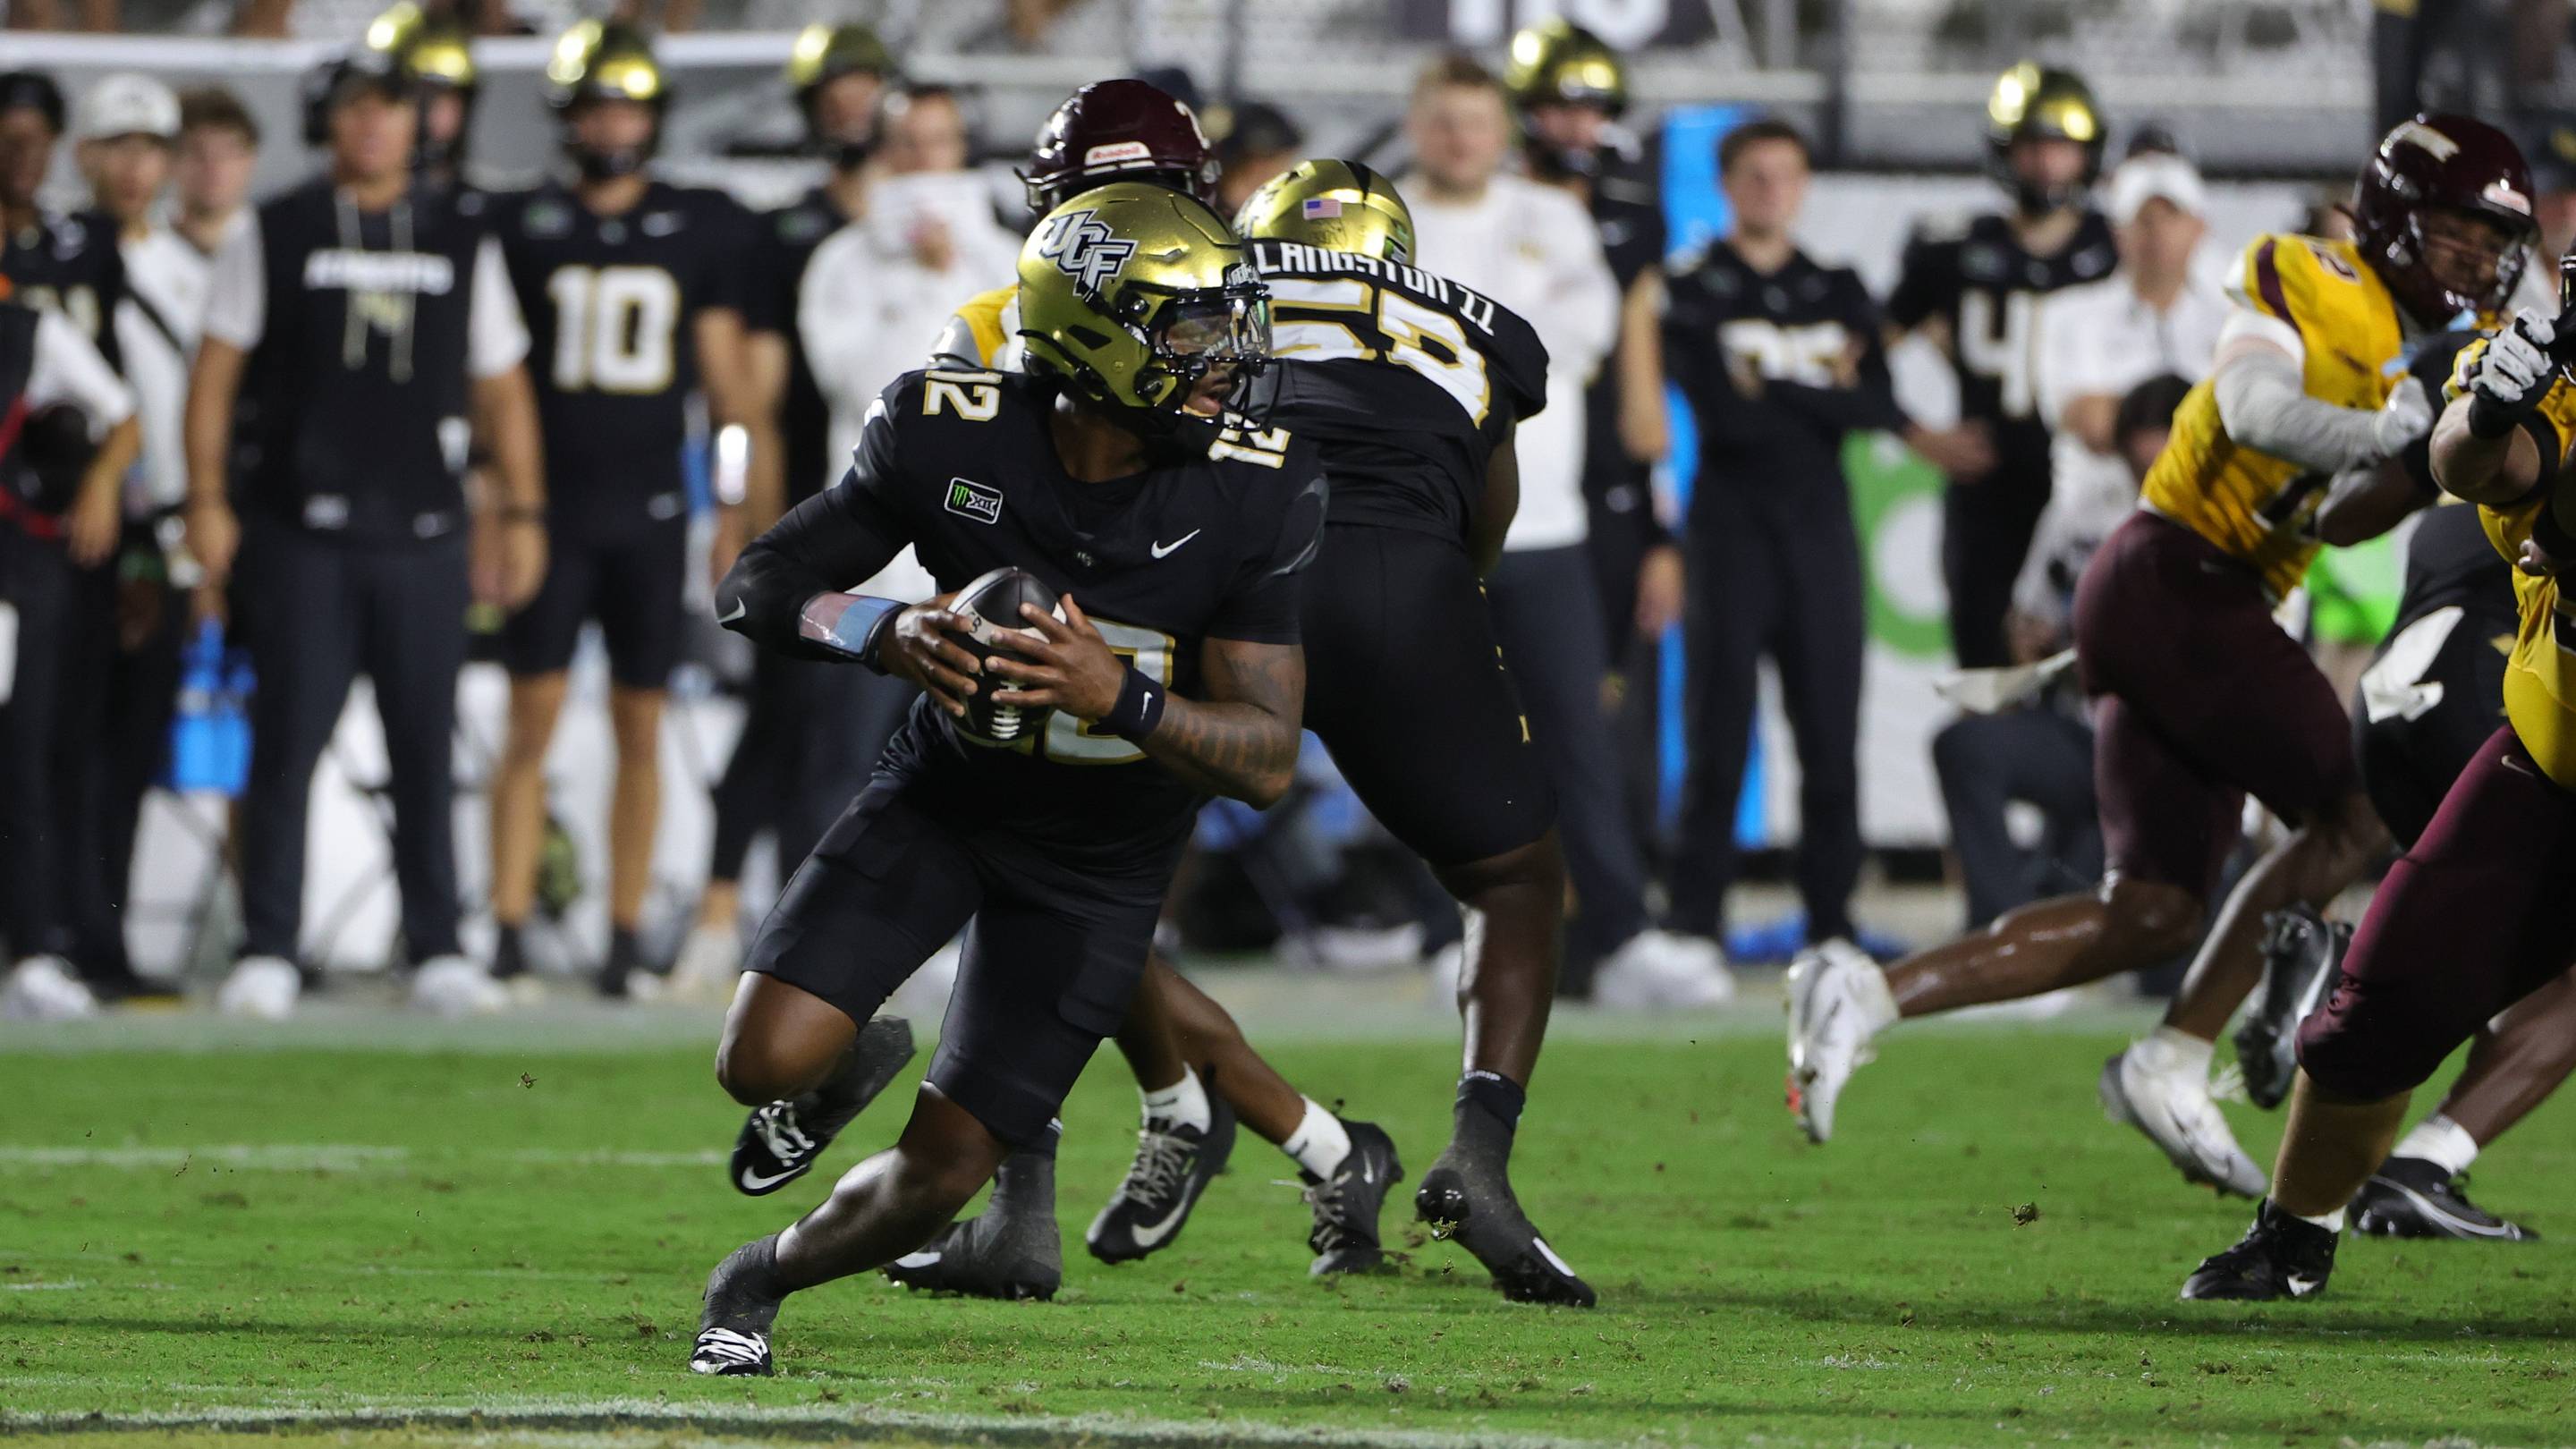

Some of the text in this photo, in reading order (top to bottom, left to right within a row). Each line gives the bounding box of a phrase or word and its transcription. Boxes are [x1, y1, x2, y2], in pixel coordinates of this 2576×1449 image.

[1038, 208, 1140, 302] UCF
[545, 264, 682, 394] 10
[921, 369, 1004, 422] 12
[1208, 411, 1292, 470] 12
